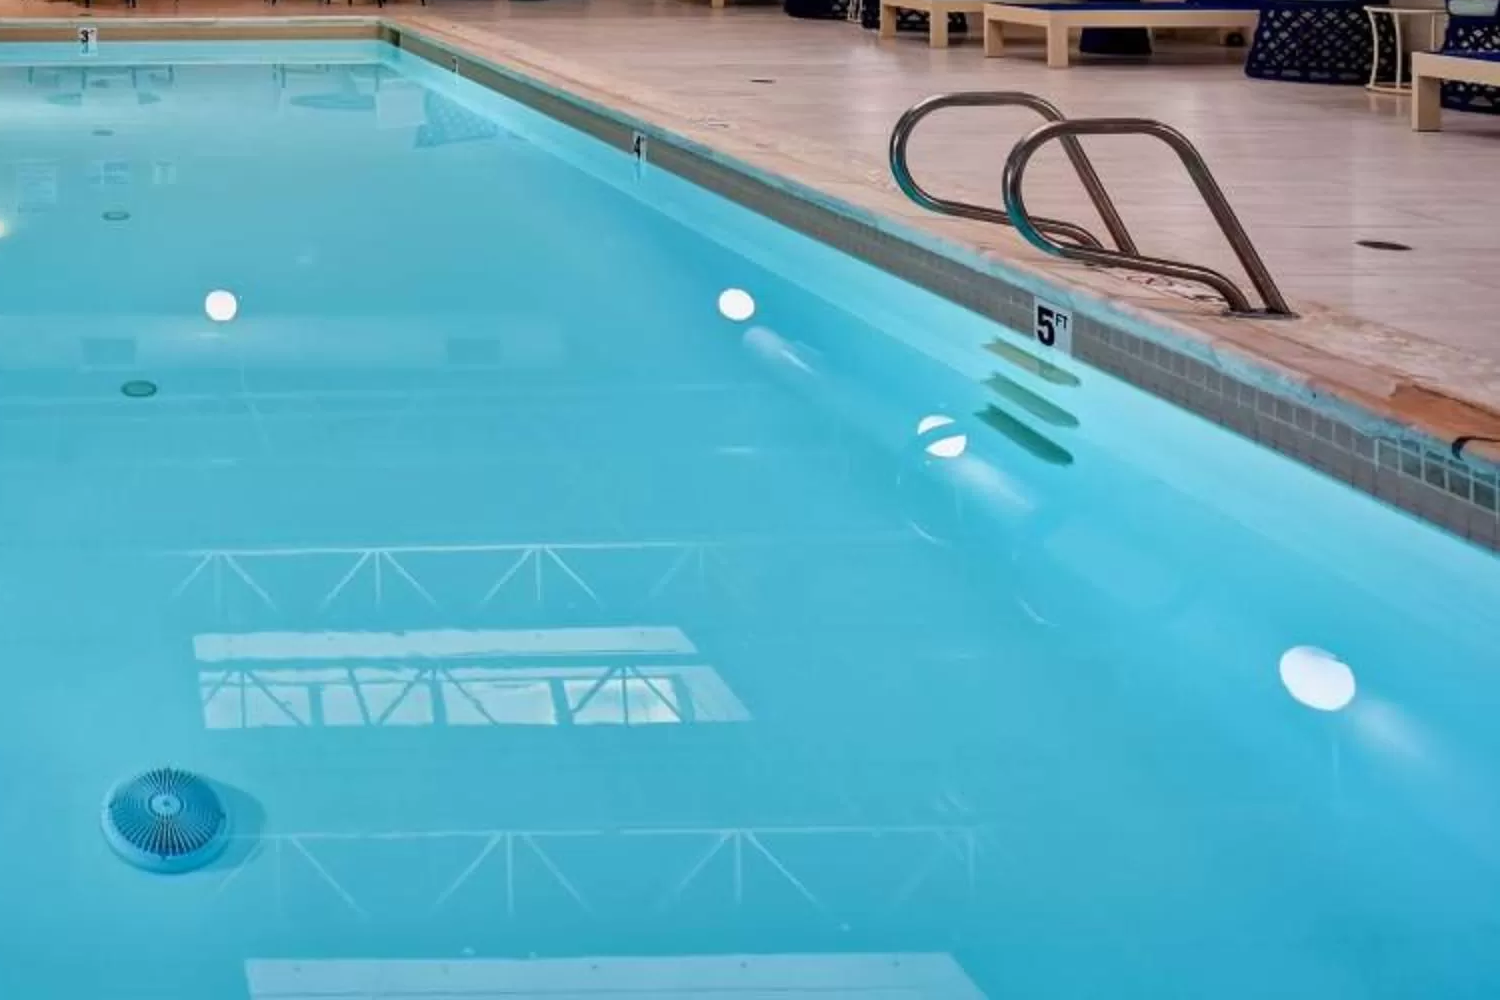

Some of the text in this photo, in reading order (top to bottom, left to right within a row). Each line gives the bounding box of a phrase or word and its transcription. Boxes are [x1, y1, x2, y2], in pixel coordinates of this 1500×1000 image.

[80, 29, 89, 43] 3
[1037, 305, 1068, 347] 5 FT
